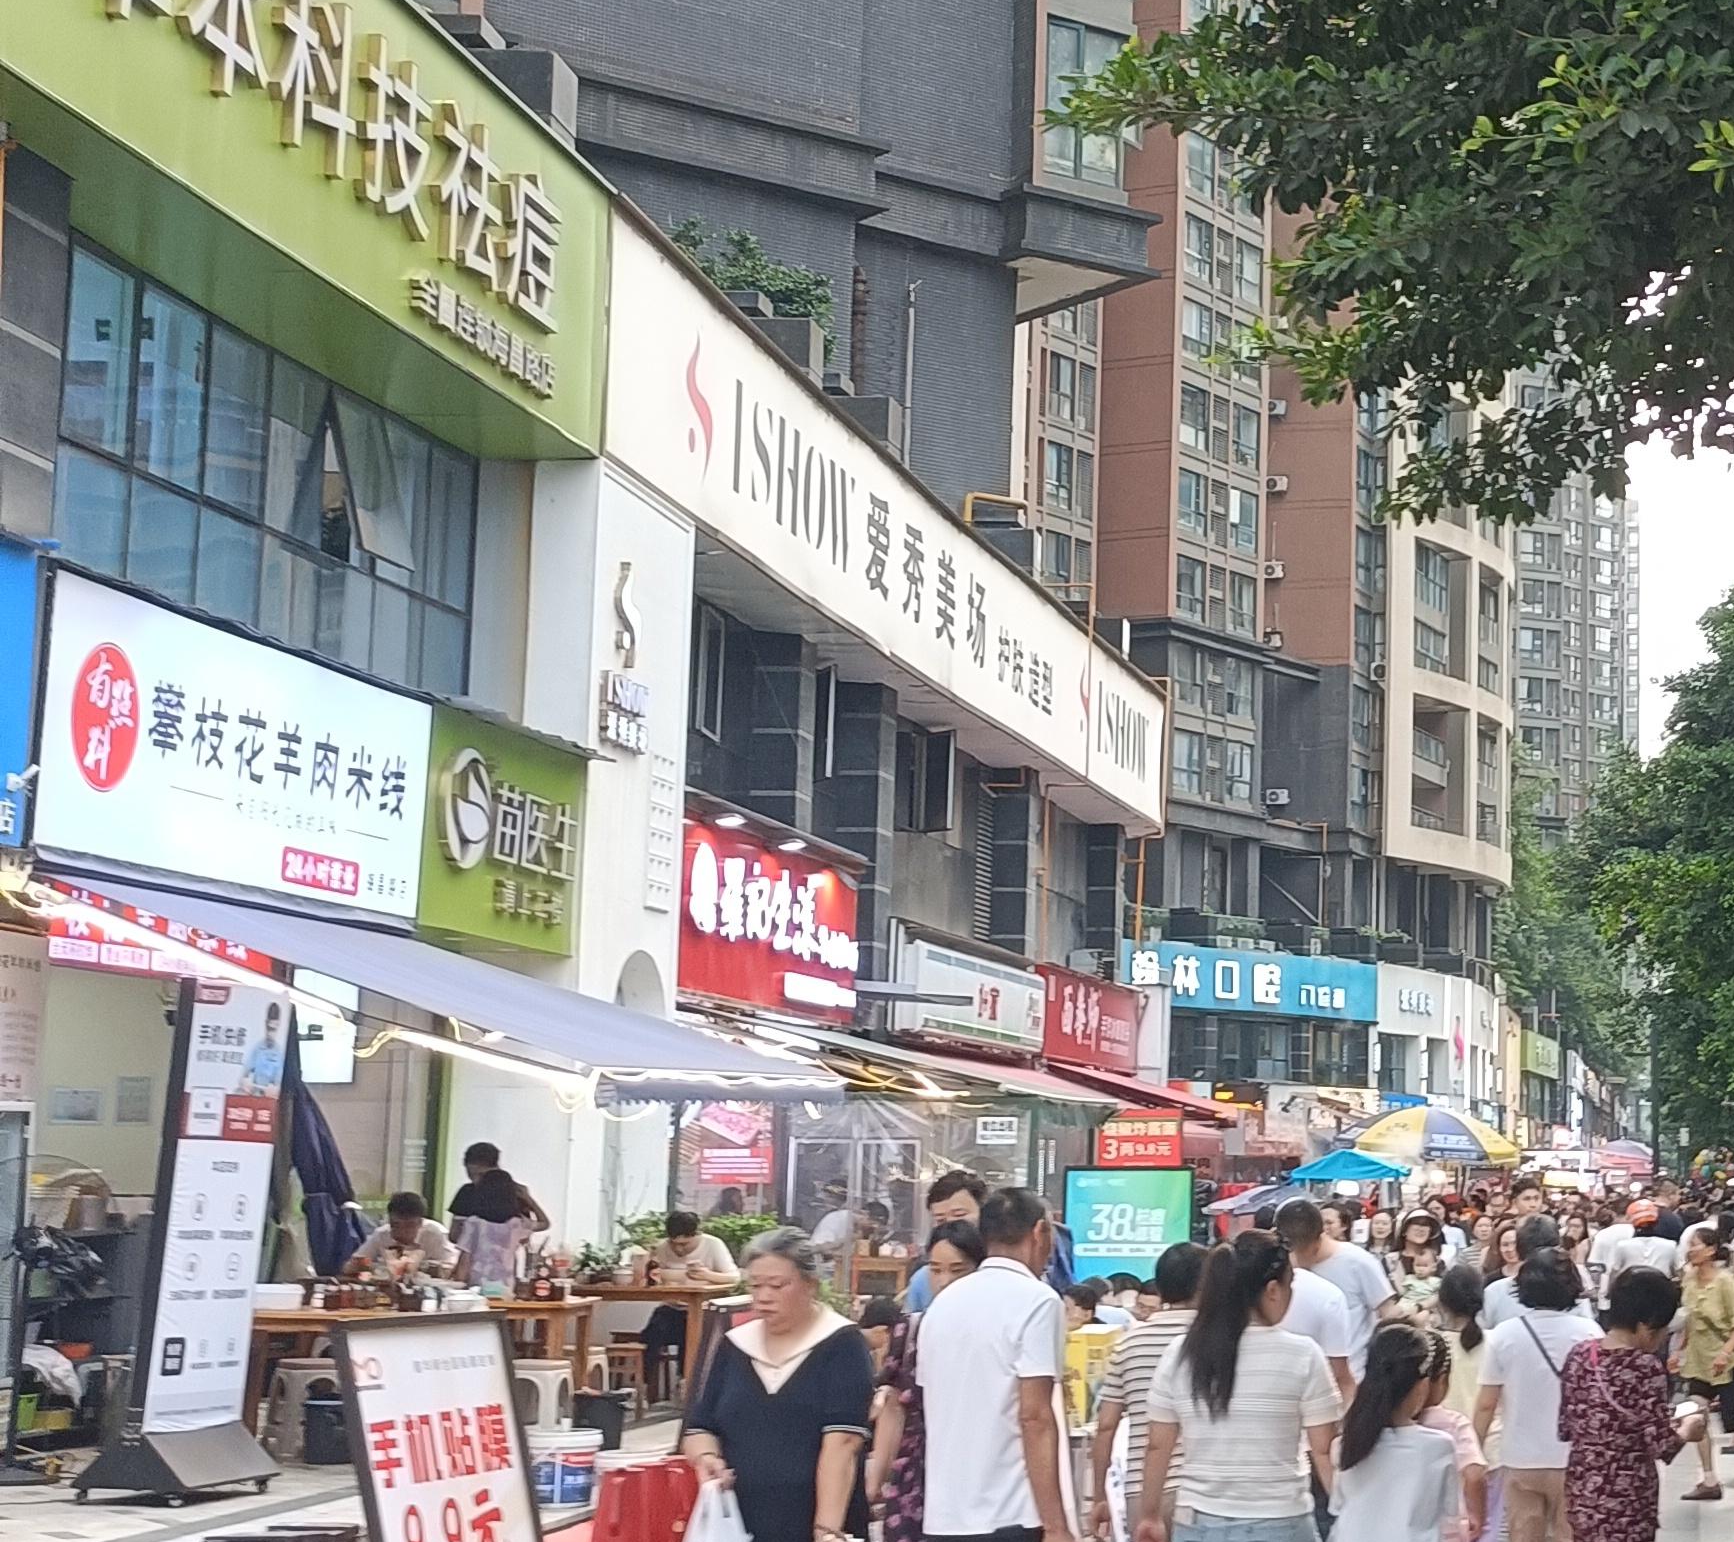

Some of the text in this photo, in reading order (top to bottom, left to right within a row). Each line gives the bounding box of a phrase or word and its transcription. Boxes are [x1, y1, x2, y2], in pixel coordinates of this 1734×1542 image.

[732, 380, 856, 573] ISHOW
[865, 492, 986, 667] 爱秀美场
[149, 679, 406, 820] 攀枝花羊肉米线
[493, 782, 578, 881] 苗医生
[1131, 950, 1282, 1004] 翰林口腔
[369, 1403, 513, 1488] 手机贴膜
